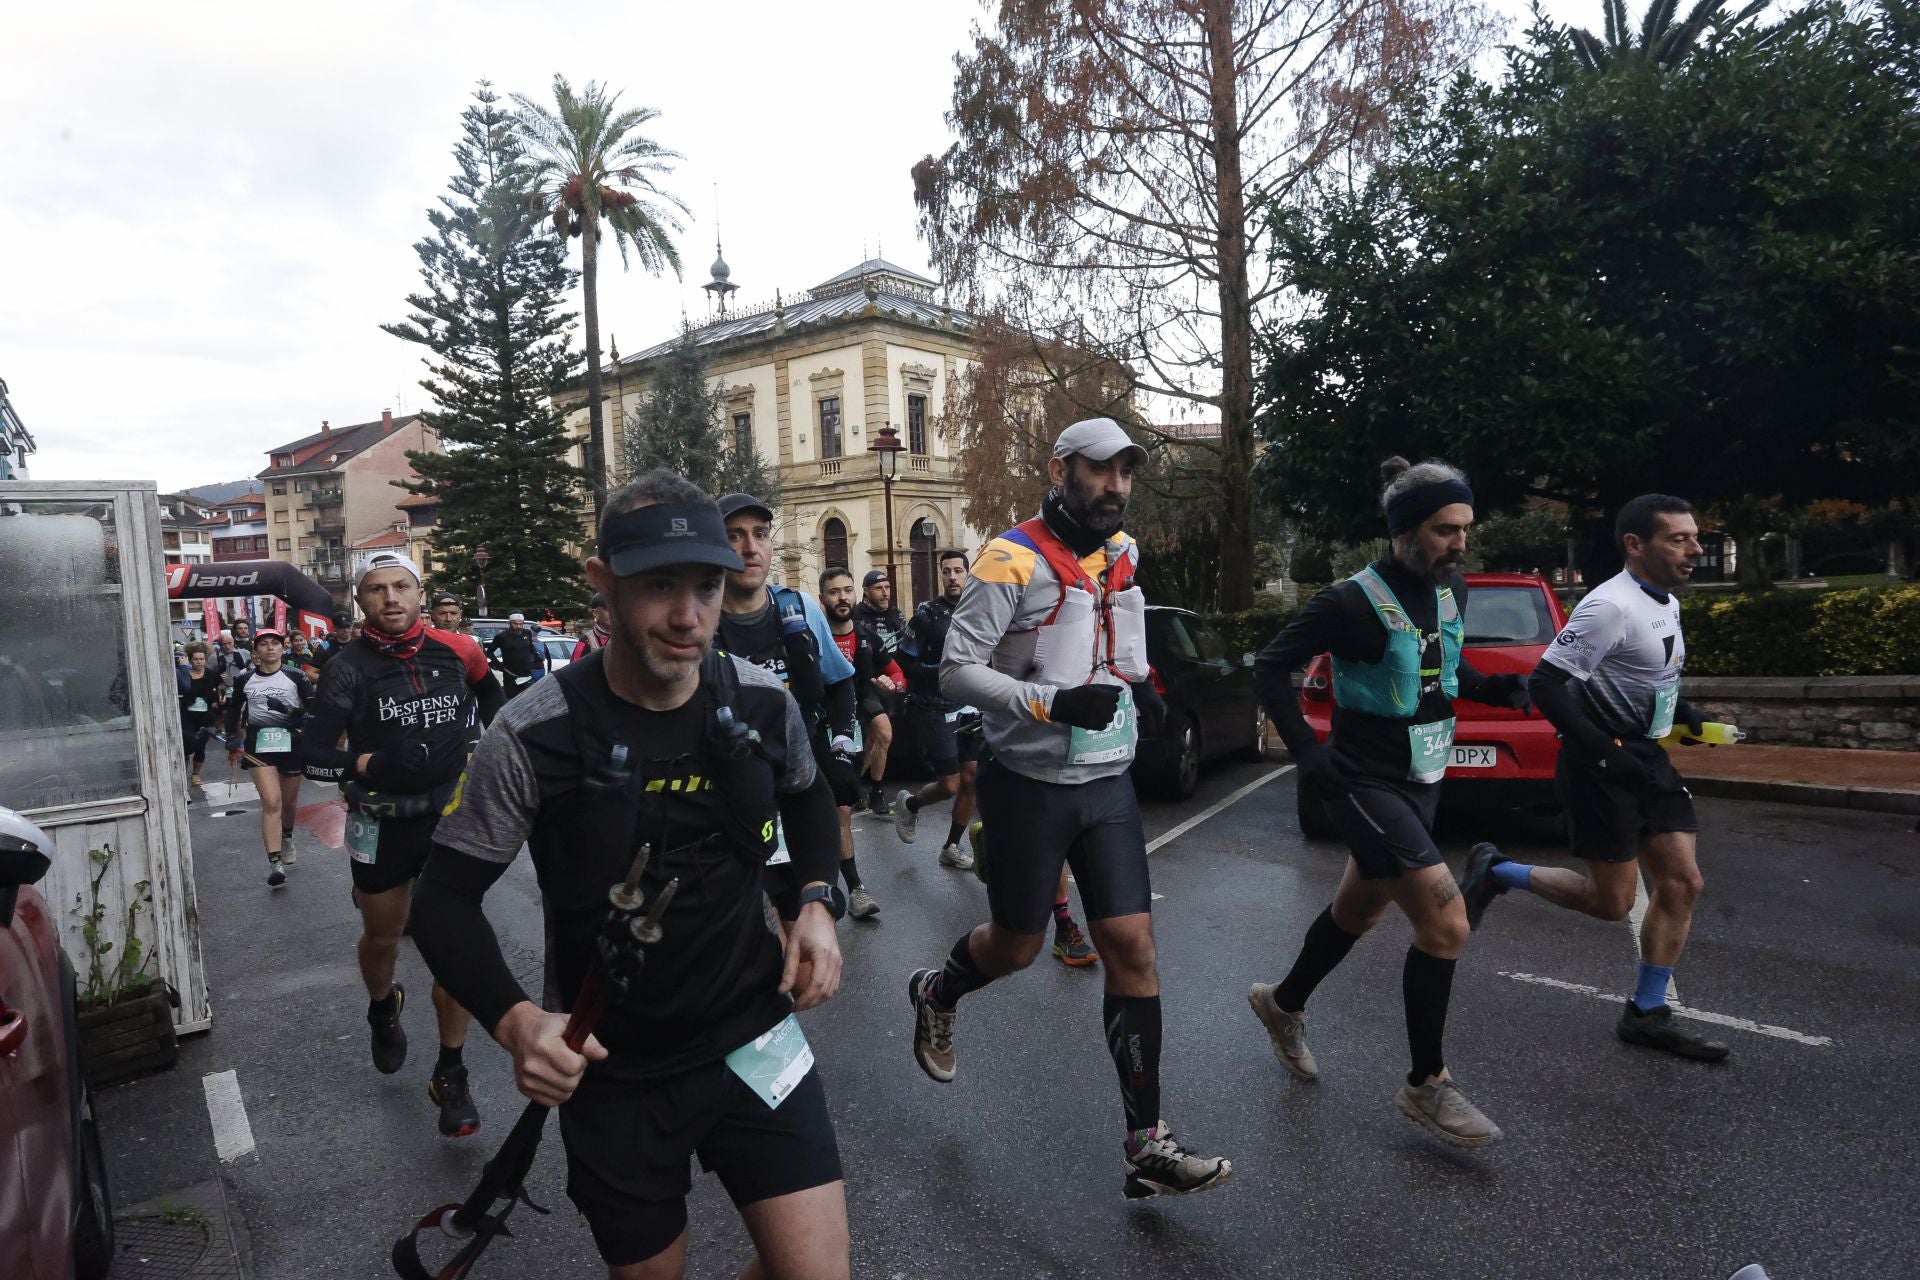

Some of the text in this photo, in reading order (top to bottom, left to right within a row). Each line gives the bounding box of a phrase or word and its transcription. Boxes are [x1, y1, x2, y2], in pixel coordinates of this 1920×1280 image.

[378, 697, 396, 709] LA
[379, 694, 460, 721] DESPENSA
[401, 708, 457, 728] DE FER
[263, 732, 282, 741] 319
[1455, 748, 1491, 765] DPX
[306, 764, 335, 778] TERREX
